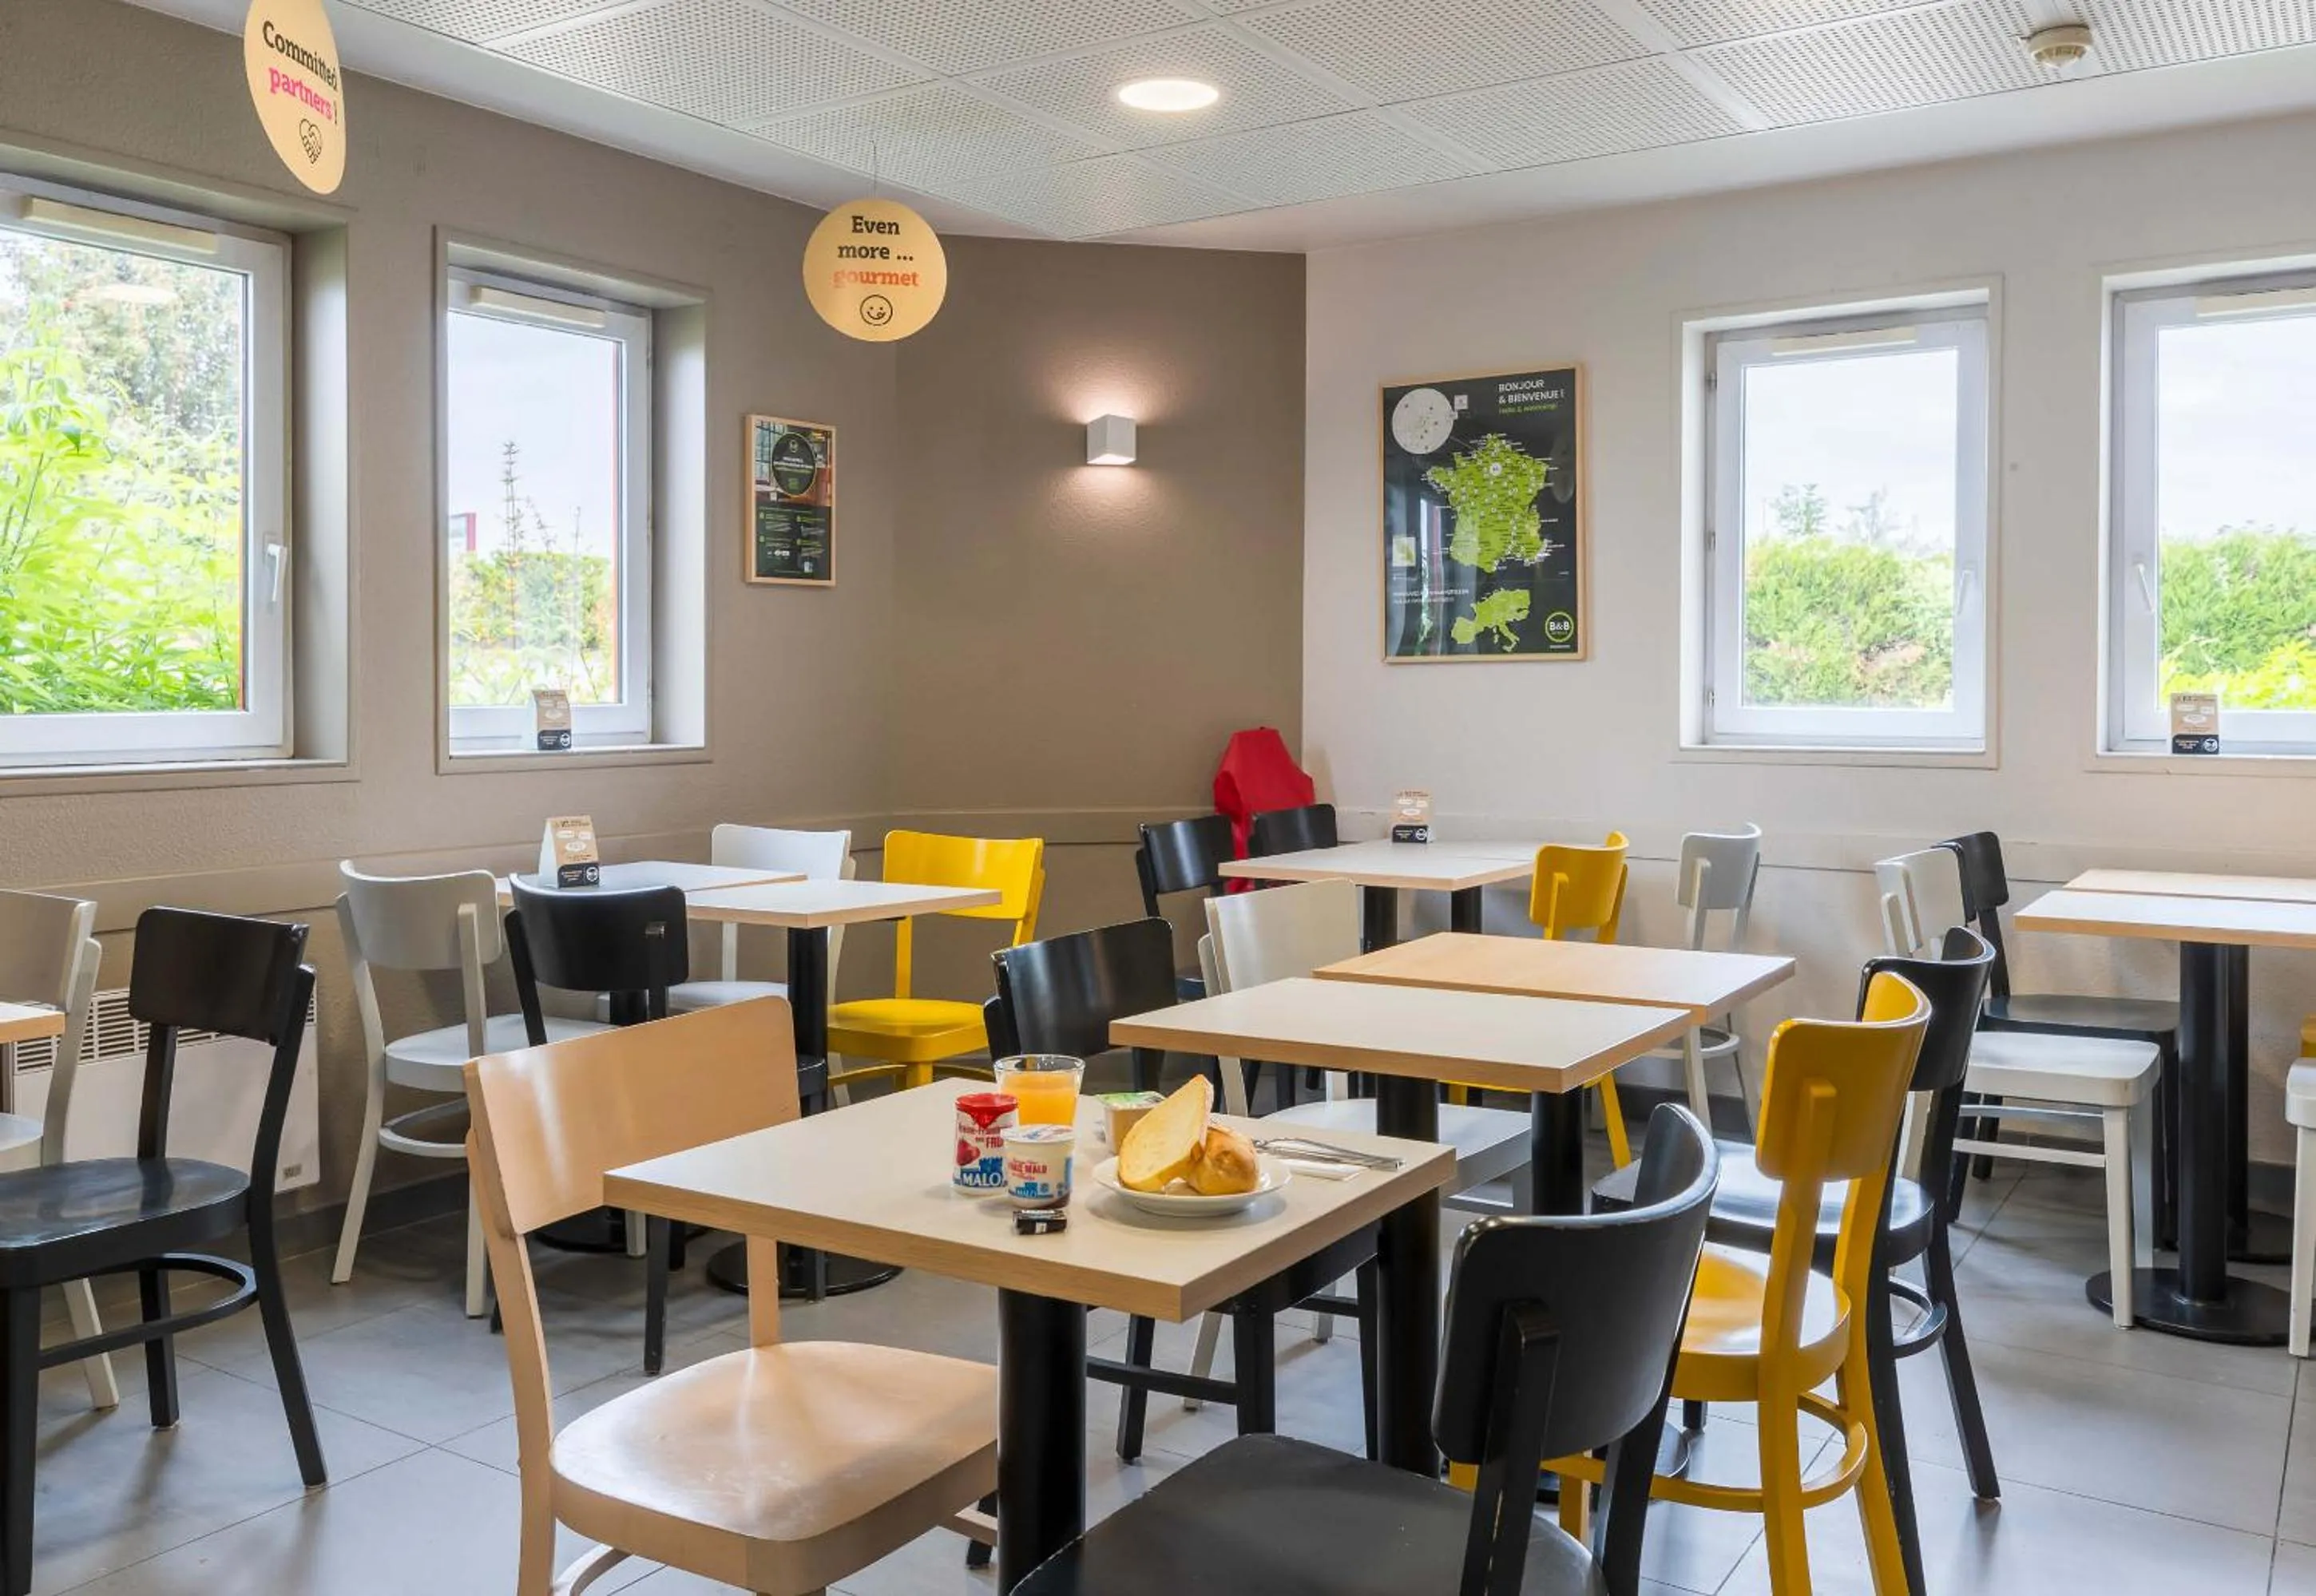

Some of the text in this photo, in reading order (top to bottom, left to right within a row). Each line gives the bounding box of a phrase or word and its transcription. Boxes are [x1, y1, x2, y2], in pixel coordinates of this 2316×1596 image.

[262, 20, 338, 92] Committed
[268, 66, 333, 121] partners
[851, 216, 900, 235] Even
[837, 244, 890, 259] more
[832, 269, 920, 288] gourmet
[1498, 379, 1545, 392] BONJOUR
[1508, 390, 1559, 403] BIENVENUE
[962, 1172, 1001, 1186] MALO
